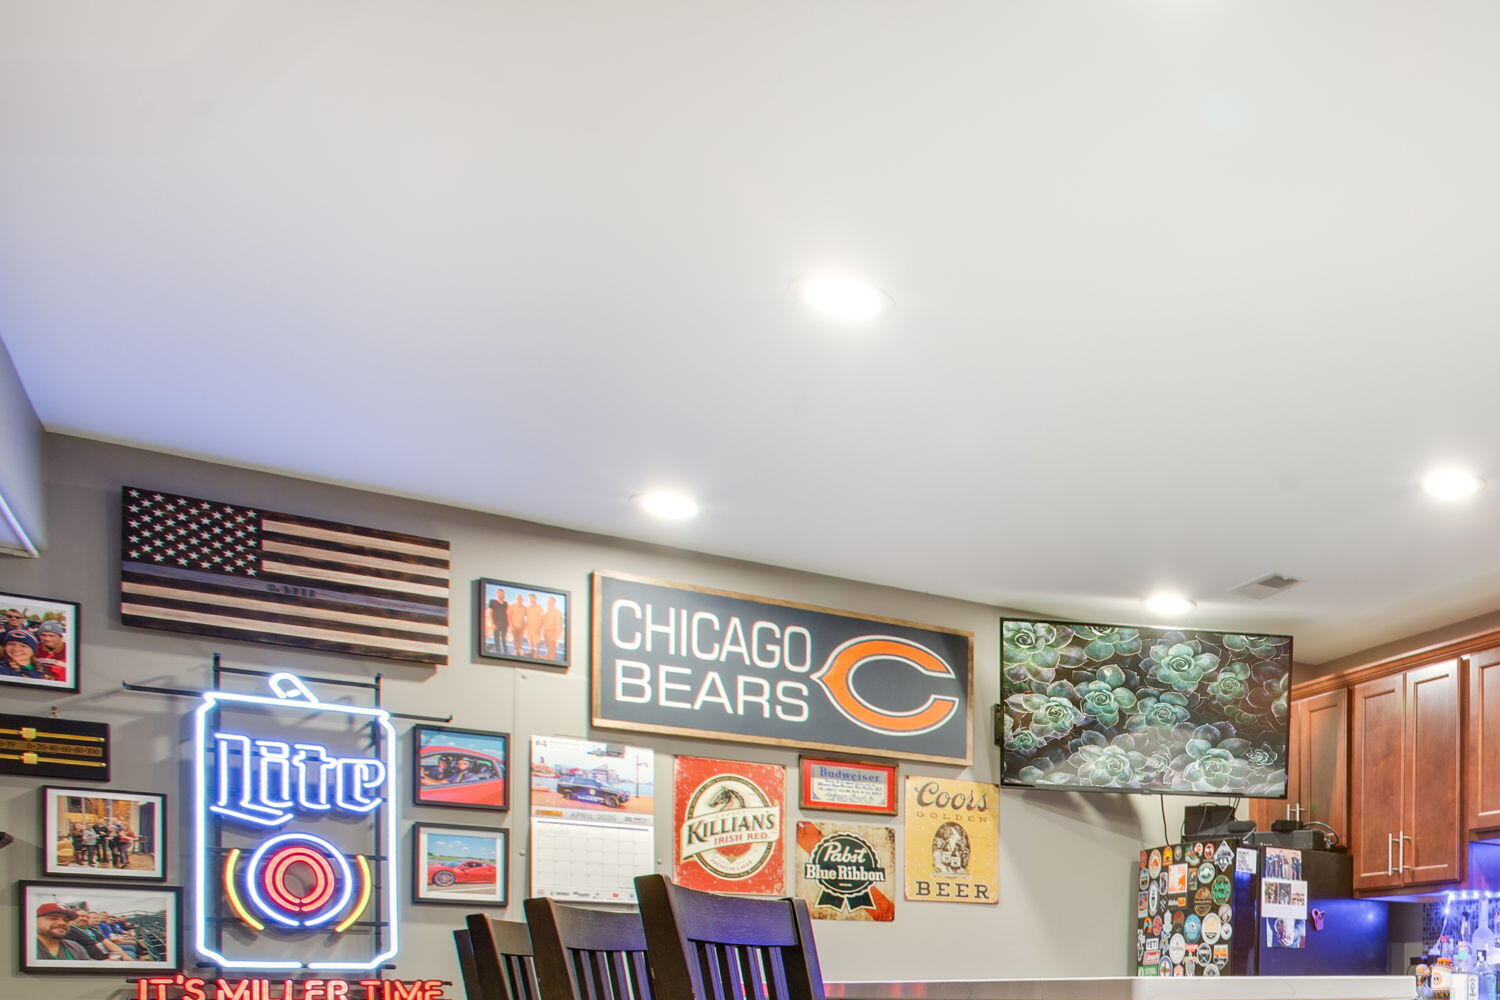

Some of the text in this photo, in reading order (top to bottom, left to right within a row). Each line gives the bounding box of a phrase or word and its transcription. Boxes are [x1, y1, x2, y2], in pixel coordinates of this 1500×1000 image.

[611, 599, 812, 673] CHICAGO
[614, 659, 809, 722] BEARS
[209, 732, 387, 826] Lite
[819, 766, 881, 782] Budweiser
[914, 782, 989, 812] Coors
[687, 810, 776, 845] KILLIAN'S
[916, 811, 988, 823] GOLDEN
[714, 831, 769, 846] IRISH RED
[823, 841, 867, 863] Pabst
[805, 863, 885, 881] Blue Ribbon
[915, 880, 990, 900] BEER
